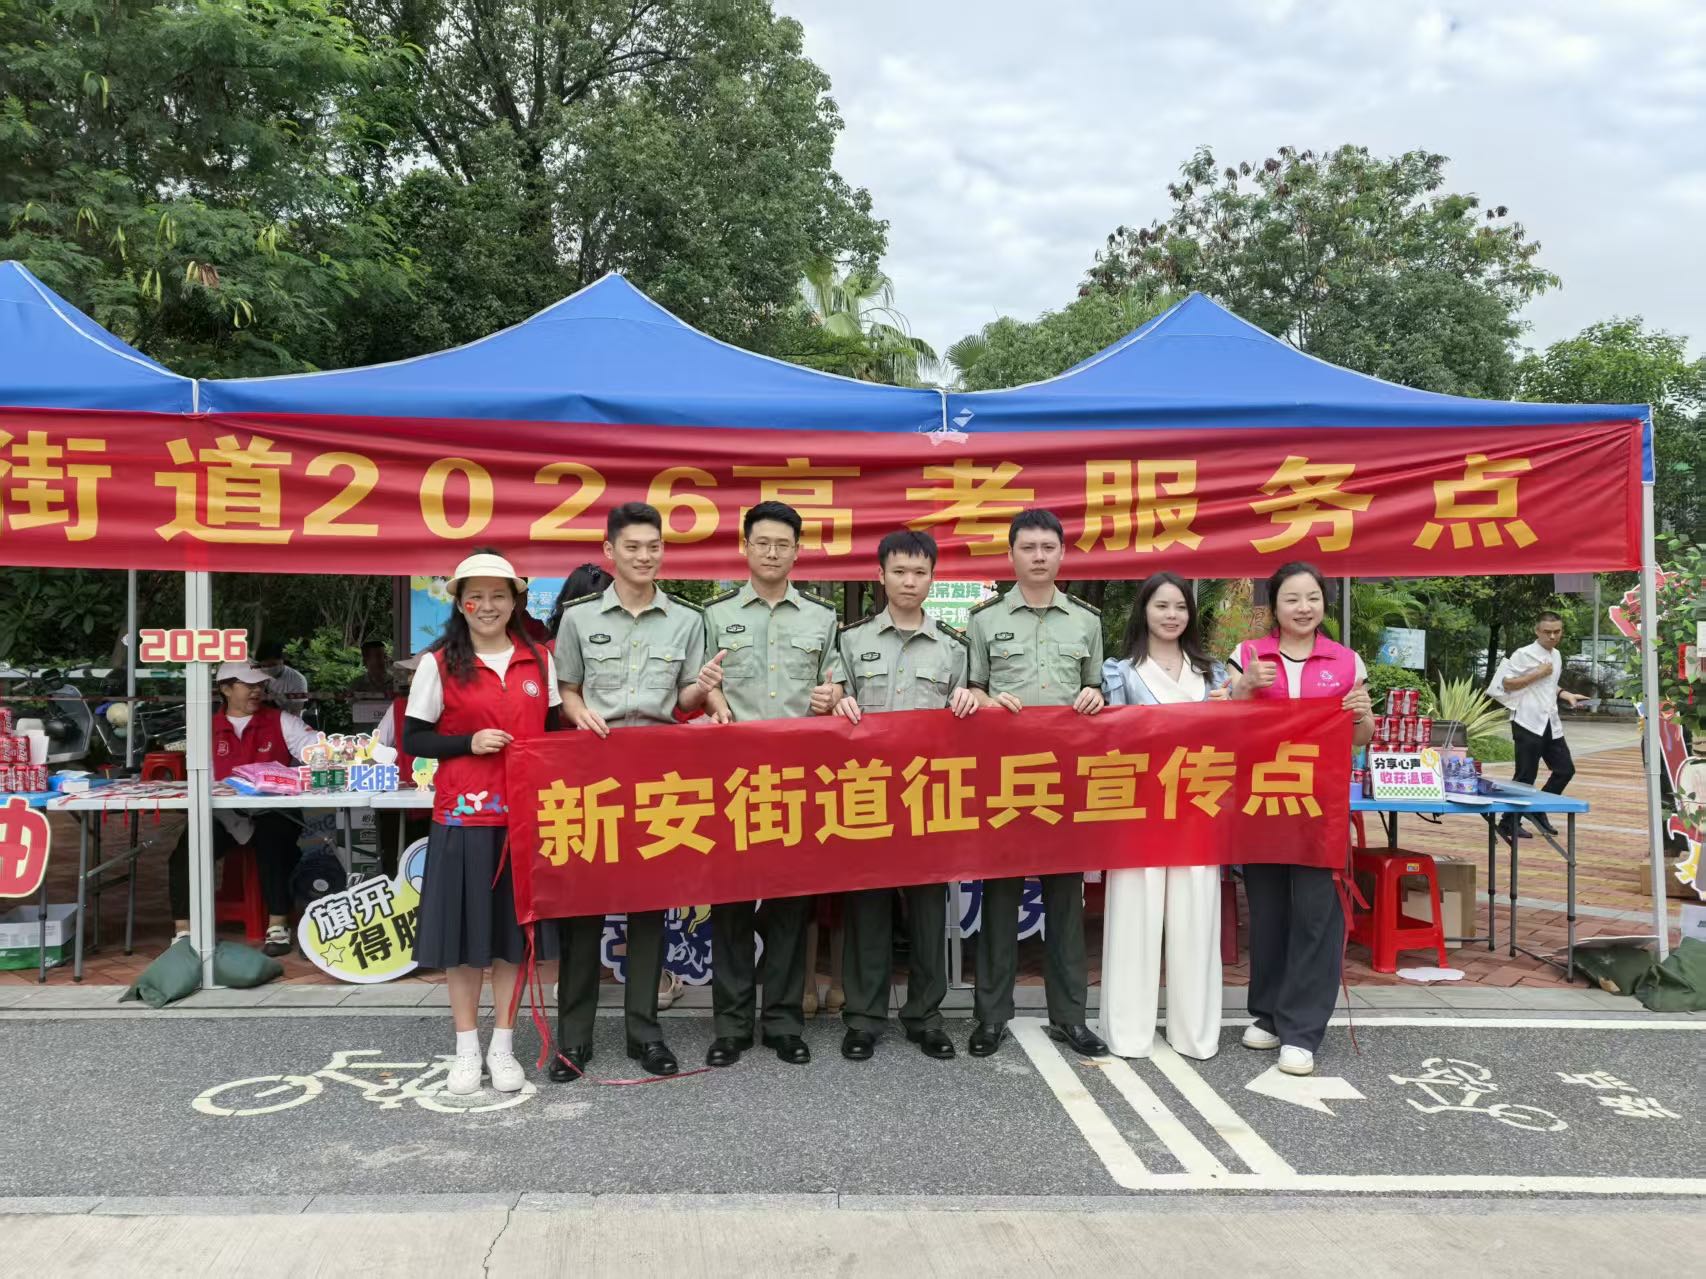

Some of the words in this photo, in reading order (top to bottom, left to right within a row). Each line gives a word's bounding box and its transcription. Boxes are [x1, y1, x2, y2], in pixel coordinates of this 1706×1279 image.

[140, 629, 247, 661] 2026
[1374, 757, 1421, 770] 分享心声
[1379, 771, 1435, 785] 收获温暖
[536, 741, 1323, 866] 新安街道征兵宣传点
[310, 878, 395, 944] 旗开
